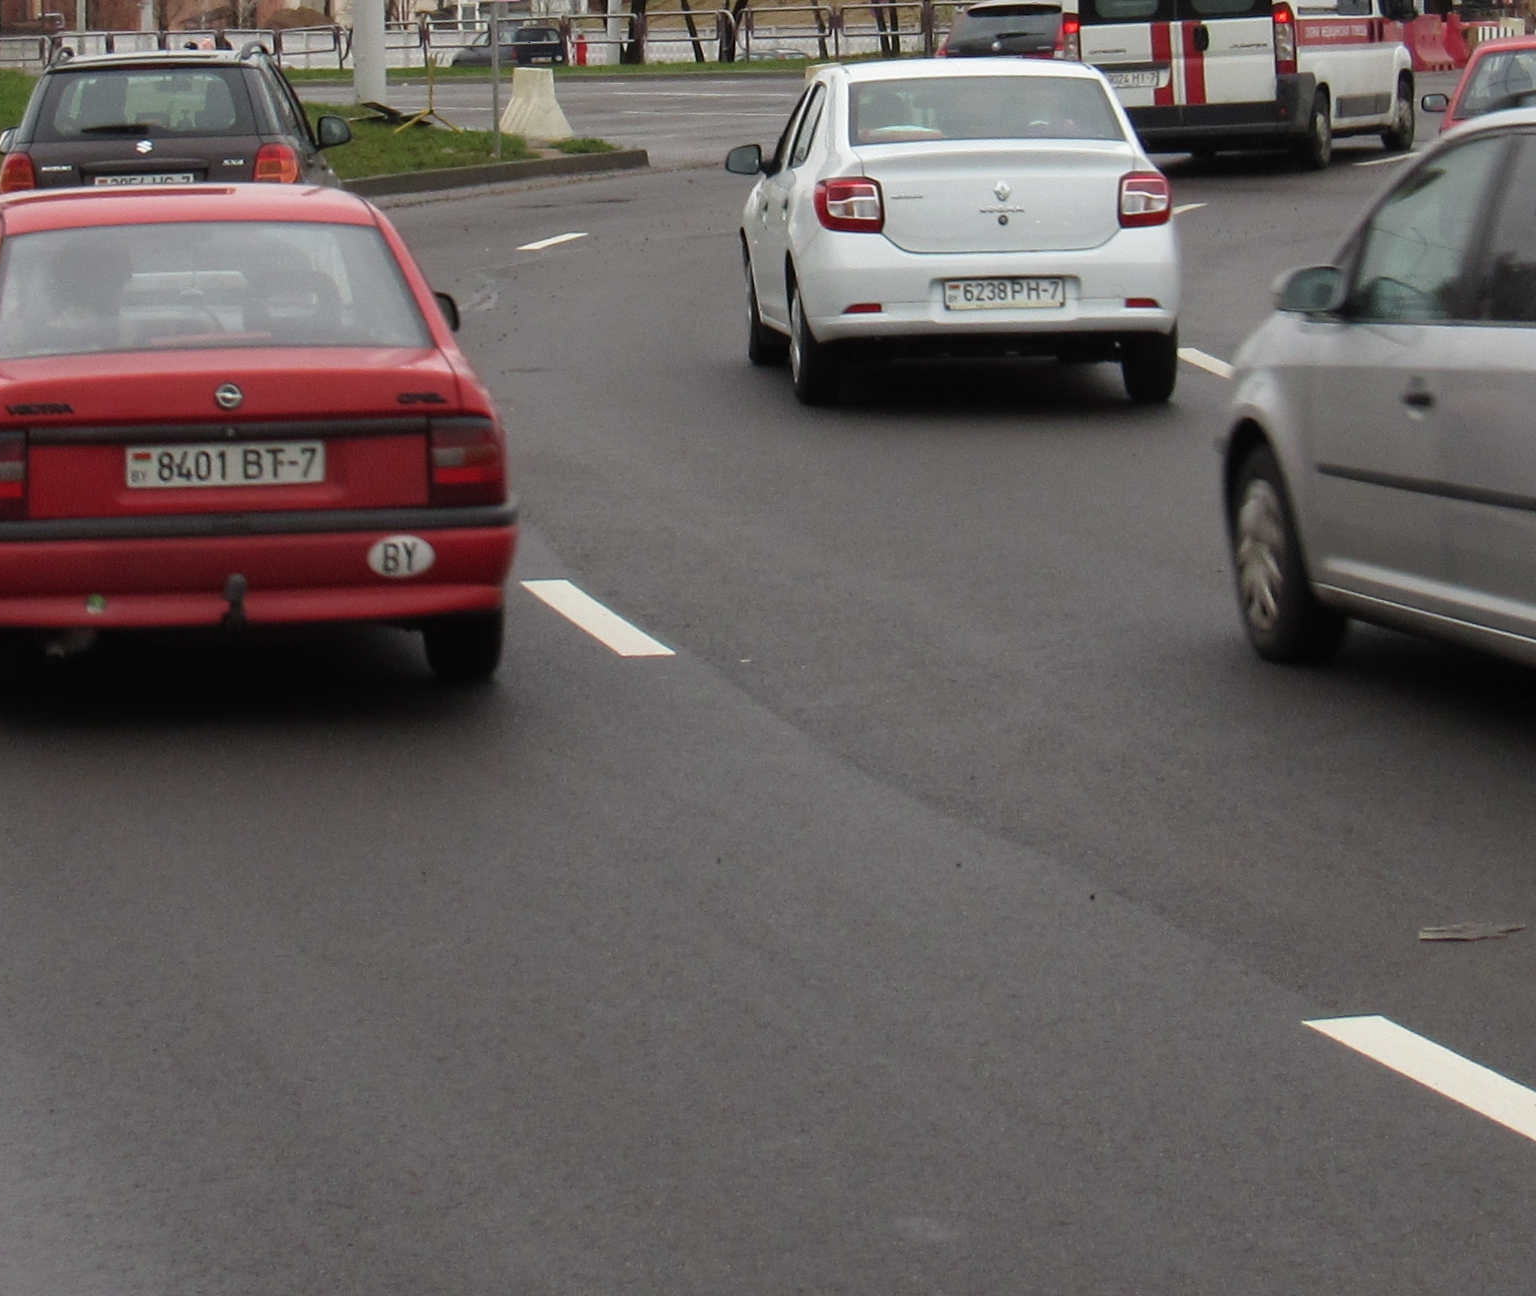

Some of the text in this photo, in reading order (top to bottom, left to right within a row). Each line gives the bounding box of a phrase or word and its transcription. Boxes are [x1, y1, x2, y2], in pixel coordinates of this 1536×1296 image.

[964, 281, 1060, 301] 6238 PH-7
[157, 447, 317, 481] 8401 BT-7
[383, 543, 418, 572] BY
